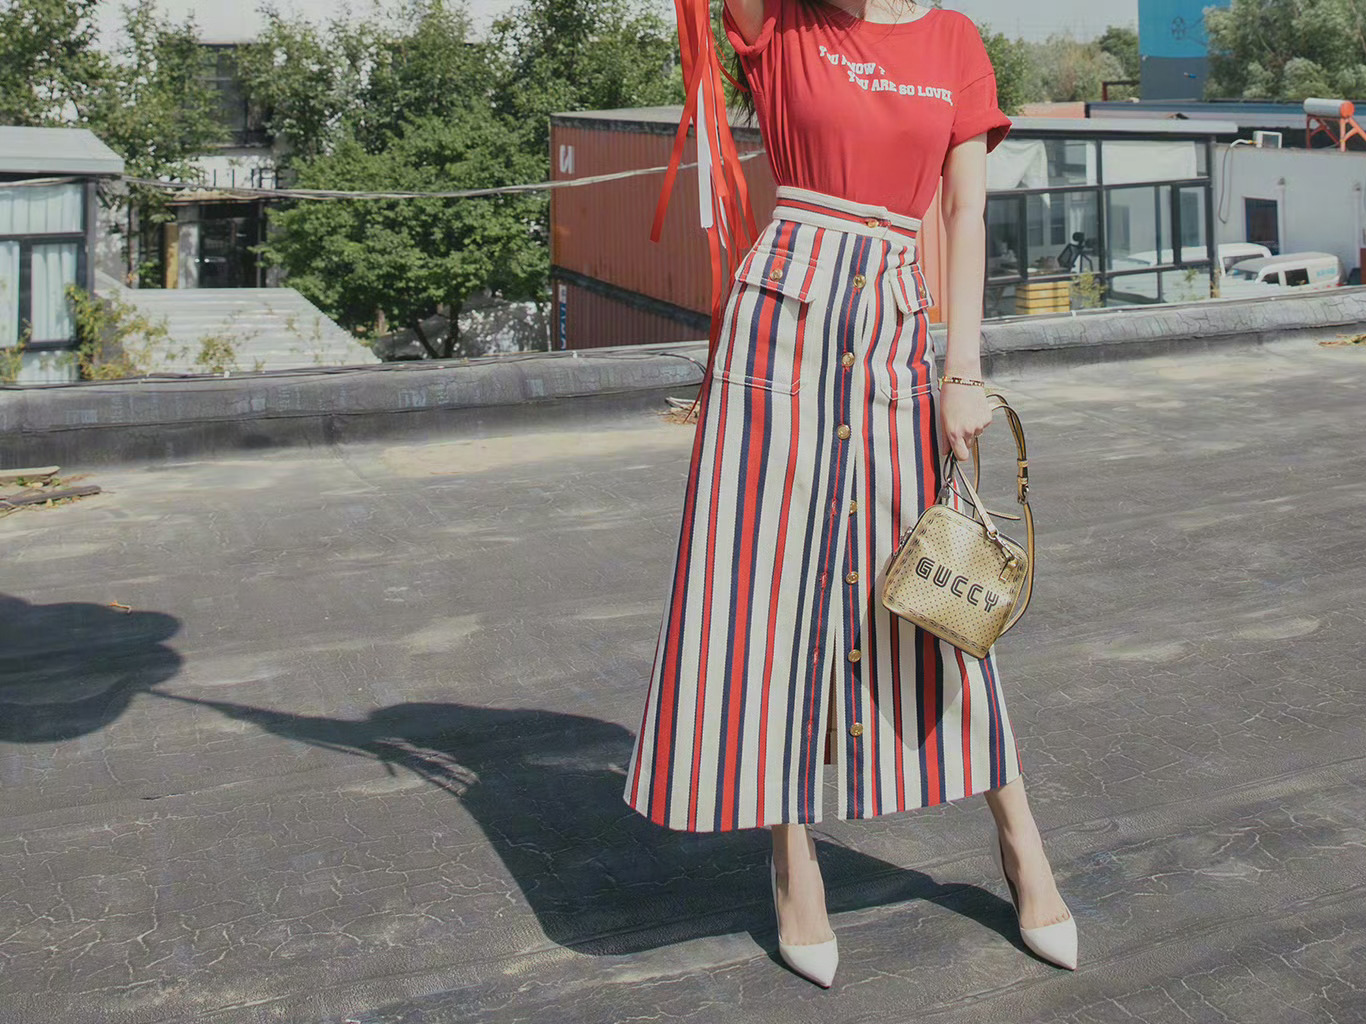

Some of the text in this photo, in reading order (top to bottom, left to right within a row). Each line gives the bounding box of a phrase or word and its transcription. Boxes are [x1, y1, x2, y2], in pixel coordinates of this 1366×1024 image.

[871, 79, 897, 92] ARE
[899, 84, 915, 96] SO
[915, 556, 1000, 613] GUCCY
